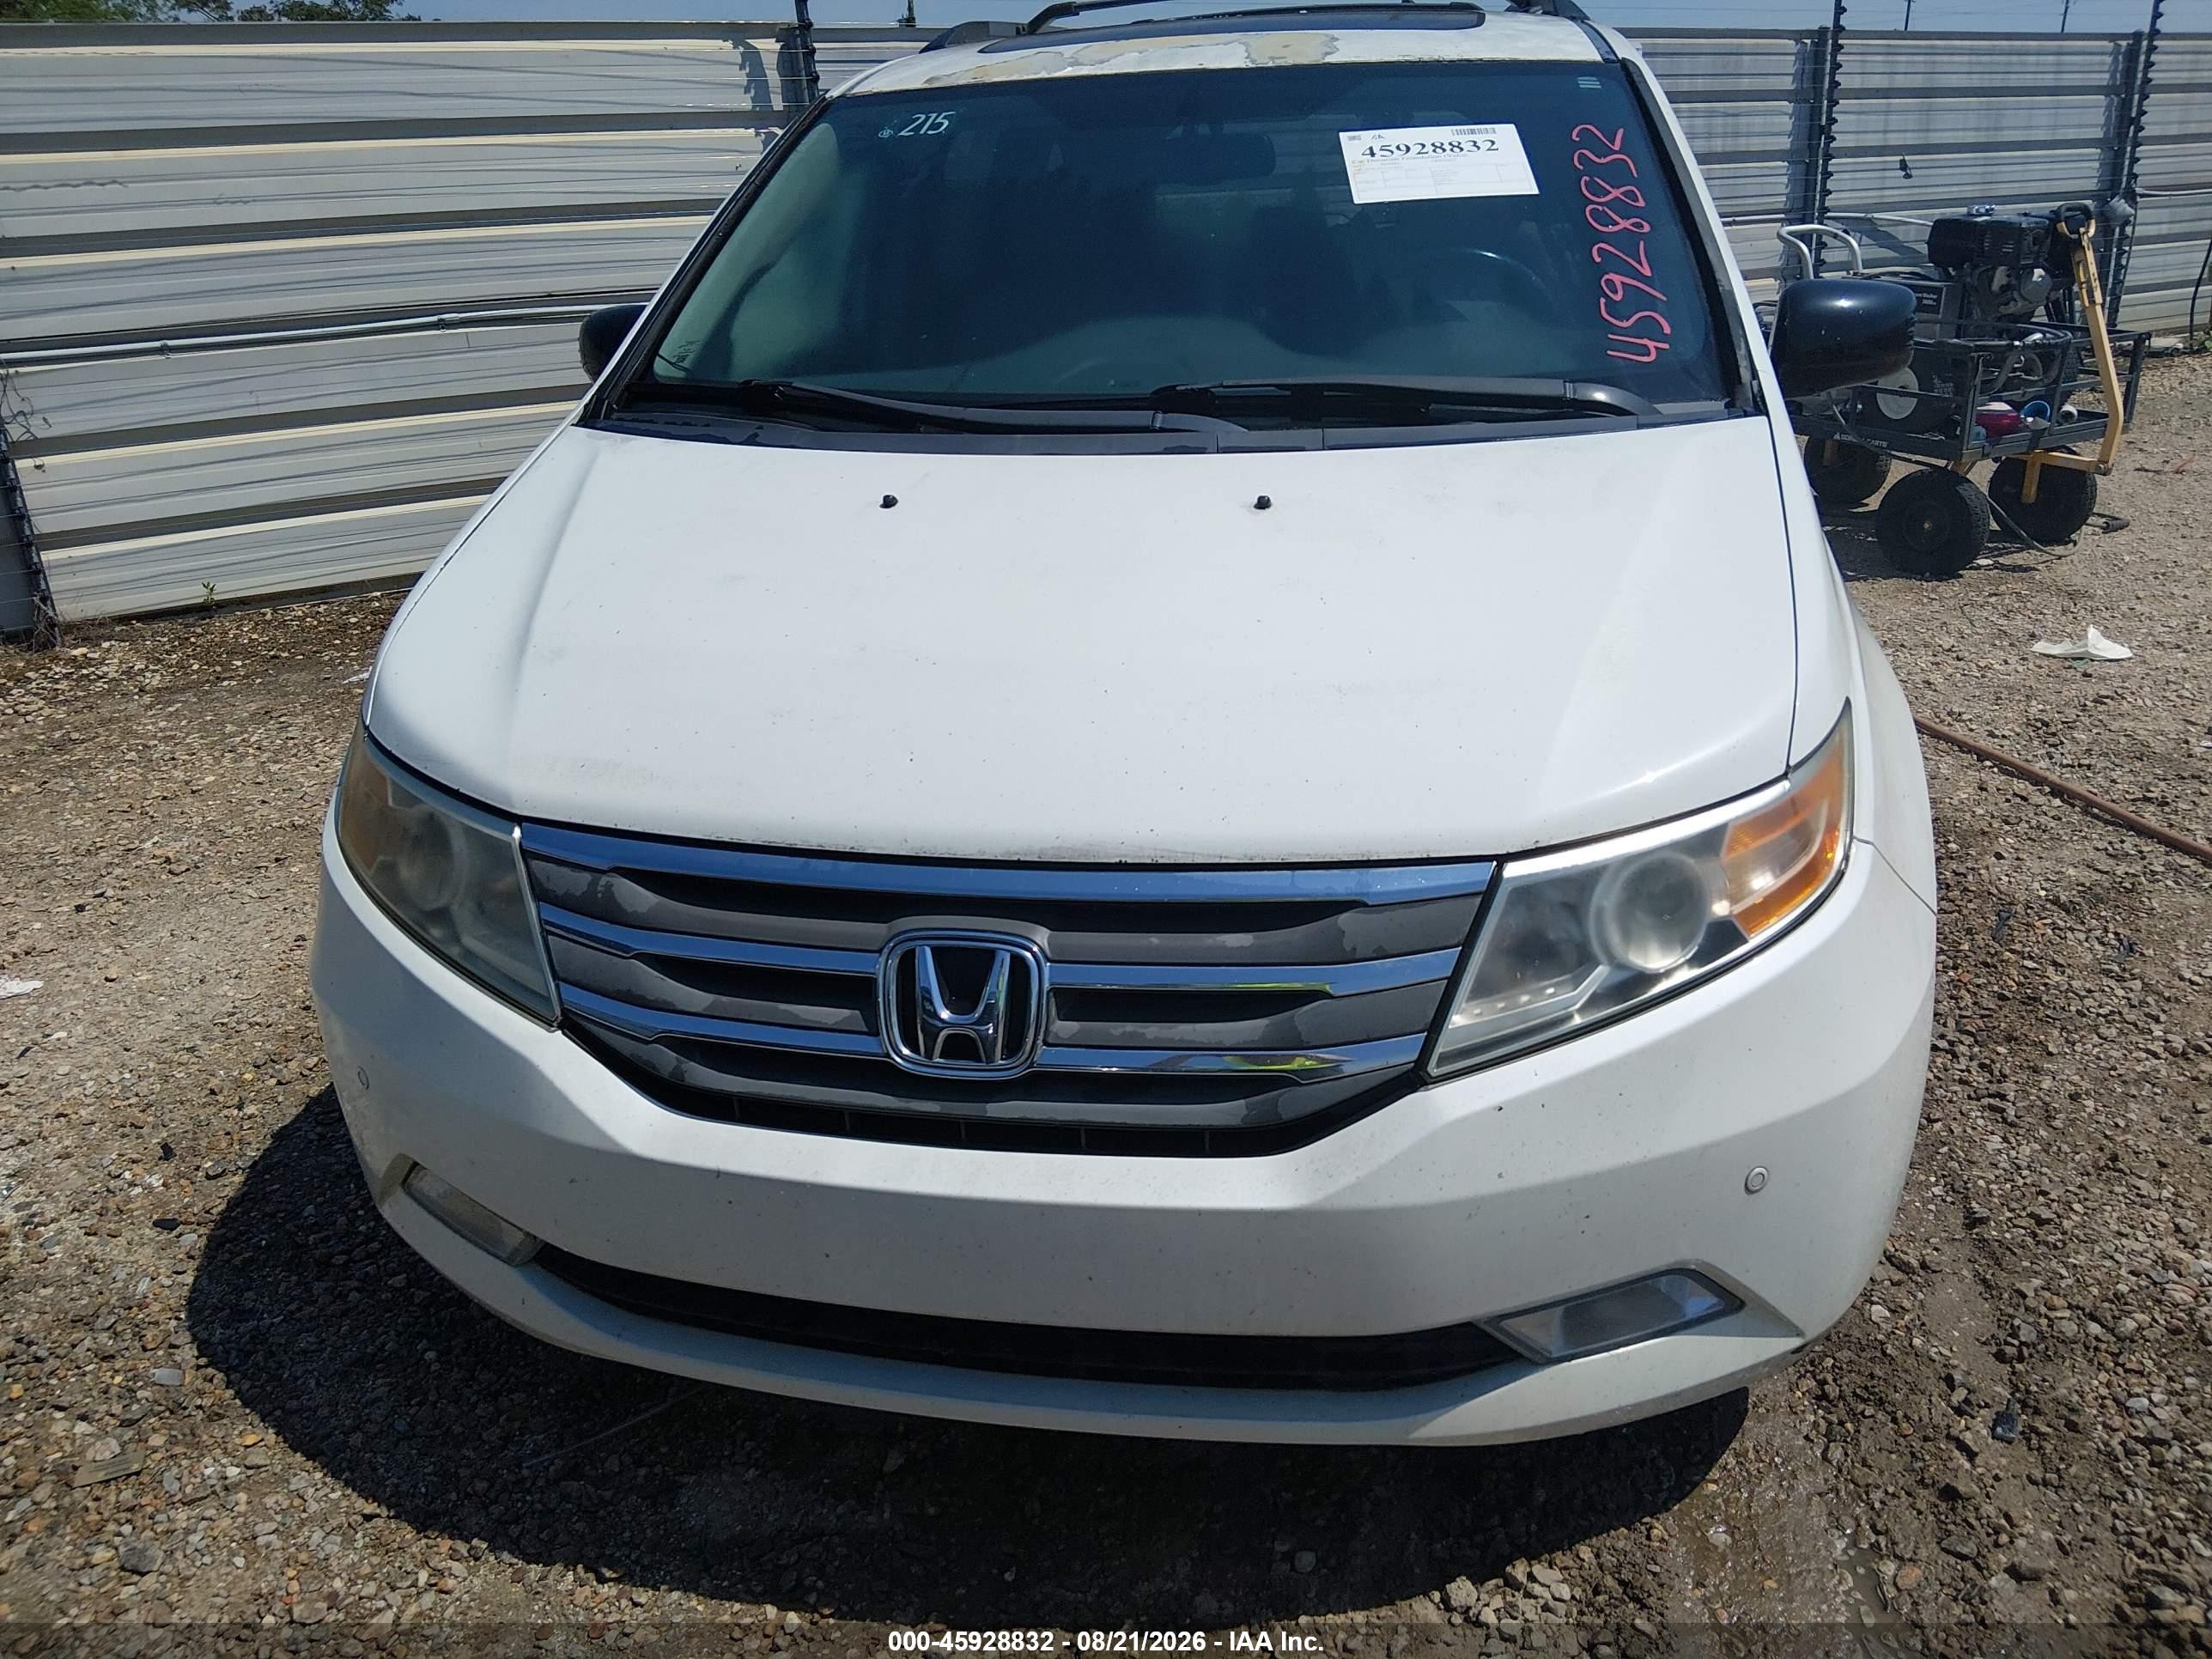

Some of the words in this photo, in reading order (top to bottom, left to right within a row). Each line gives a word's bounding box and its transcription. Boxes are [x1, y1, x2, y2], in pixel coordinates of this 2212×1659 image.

[897, 111, 956, 136] 215
[1361, 139, 1499, 158] 45928832
[1571, 124, 1671, 362] 45928832
